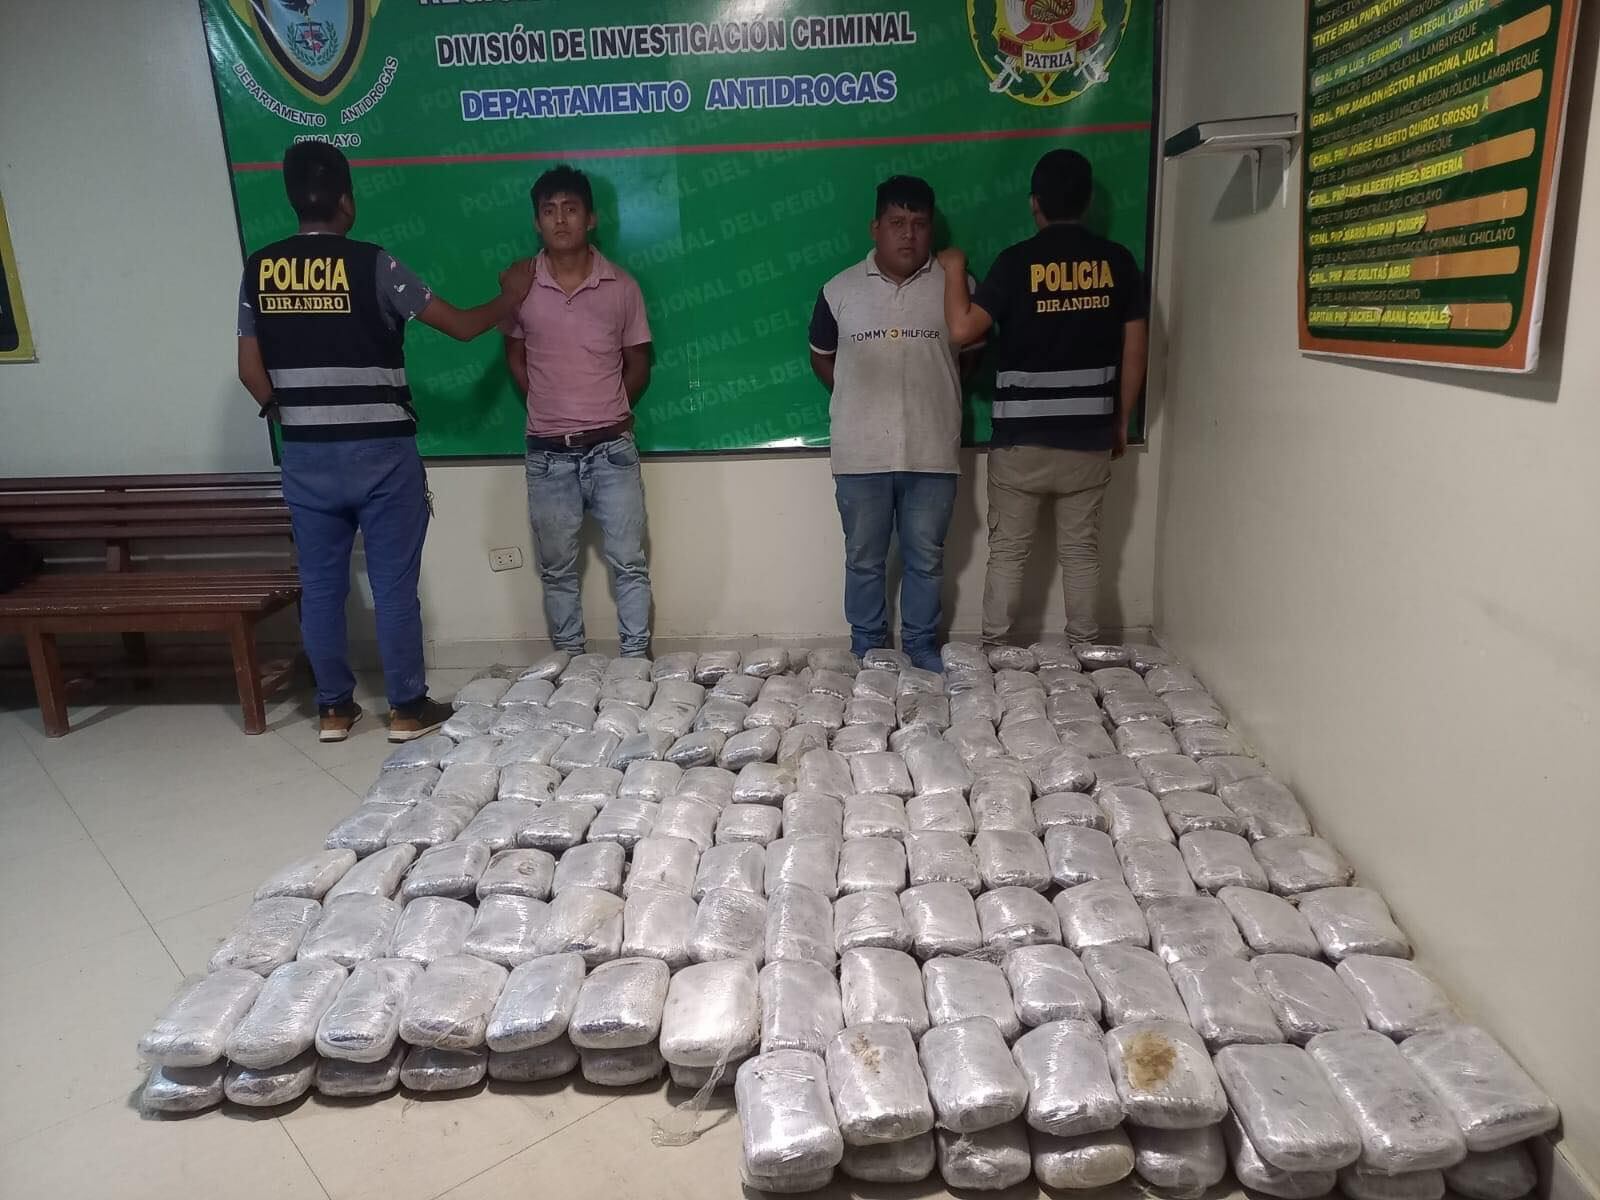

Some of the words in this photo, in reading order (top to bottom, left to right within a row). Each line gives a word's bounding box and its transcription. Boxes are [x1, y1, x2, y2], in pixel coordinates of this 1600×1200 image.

[435, 25, 546, 67] DIVISIÓN
[551, 29, 585, 62] DE
[590, 14, 785, 61] INVESTIGACIÓN
[791, 11, 917, 49] CRIMINAL
[1025, 52, 1073, 68] PATRIA
[1462, 36, 1495, 65] JULCA
[1349, 56, 1364, 73] LUIS
[233, 63, 326, 126] DEPARTAMENTO
[341, 56, 398, 124] ANTIDROGAS
[461, 82, 689, 121] DEPARTAMENTO
[704, 69, 897, 110] ANTIDROGAS
[1469, 225, 1515, 245] CHICLAYO
[266, 296, 344, 310] DIRANDRO
[1036, 295, 1110, 313] DIRANDRO
[851, 329, 888, 342] TOMMY
[901, 328, 940, 340] HILFIGER
